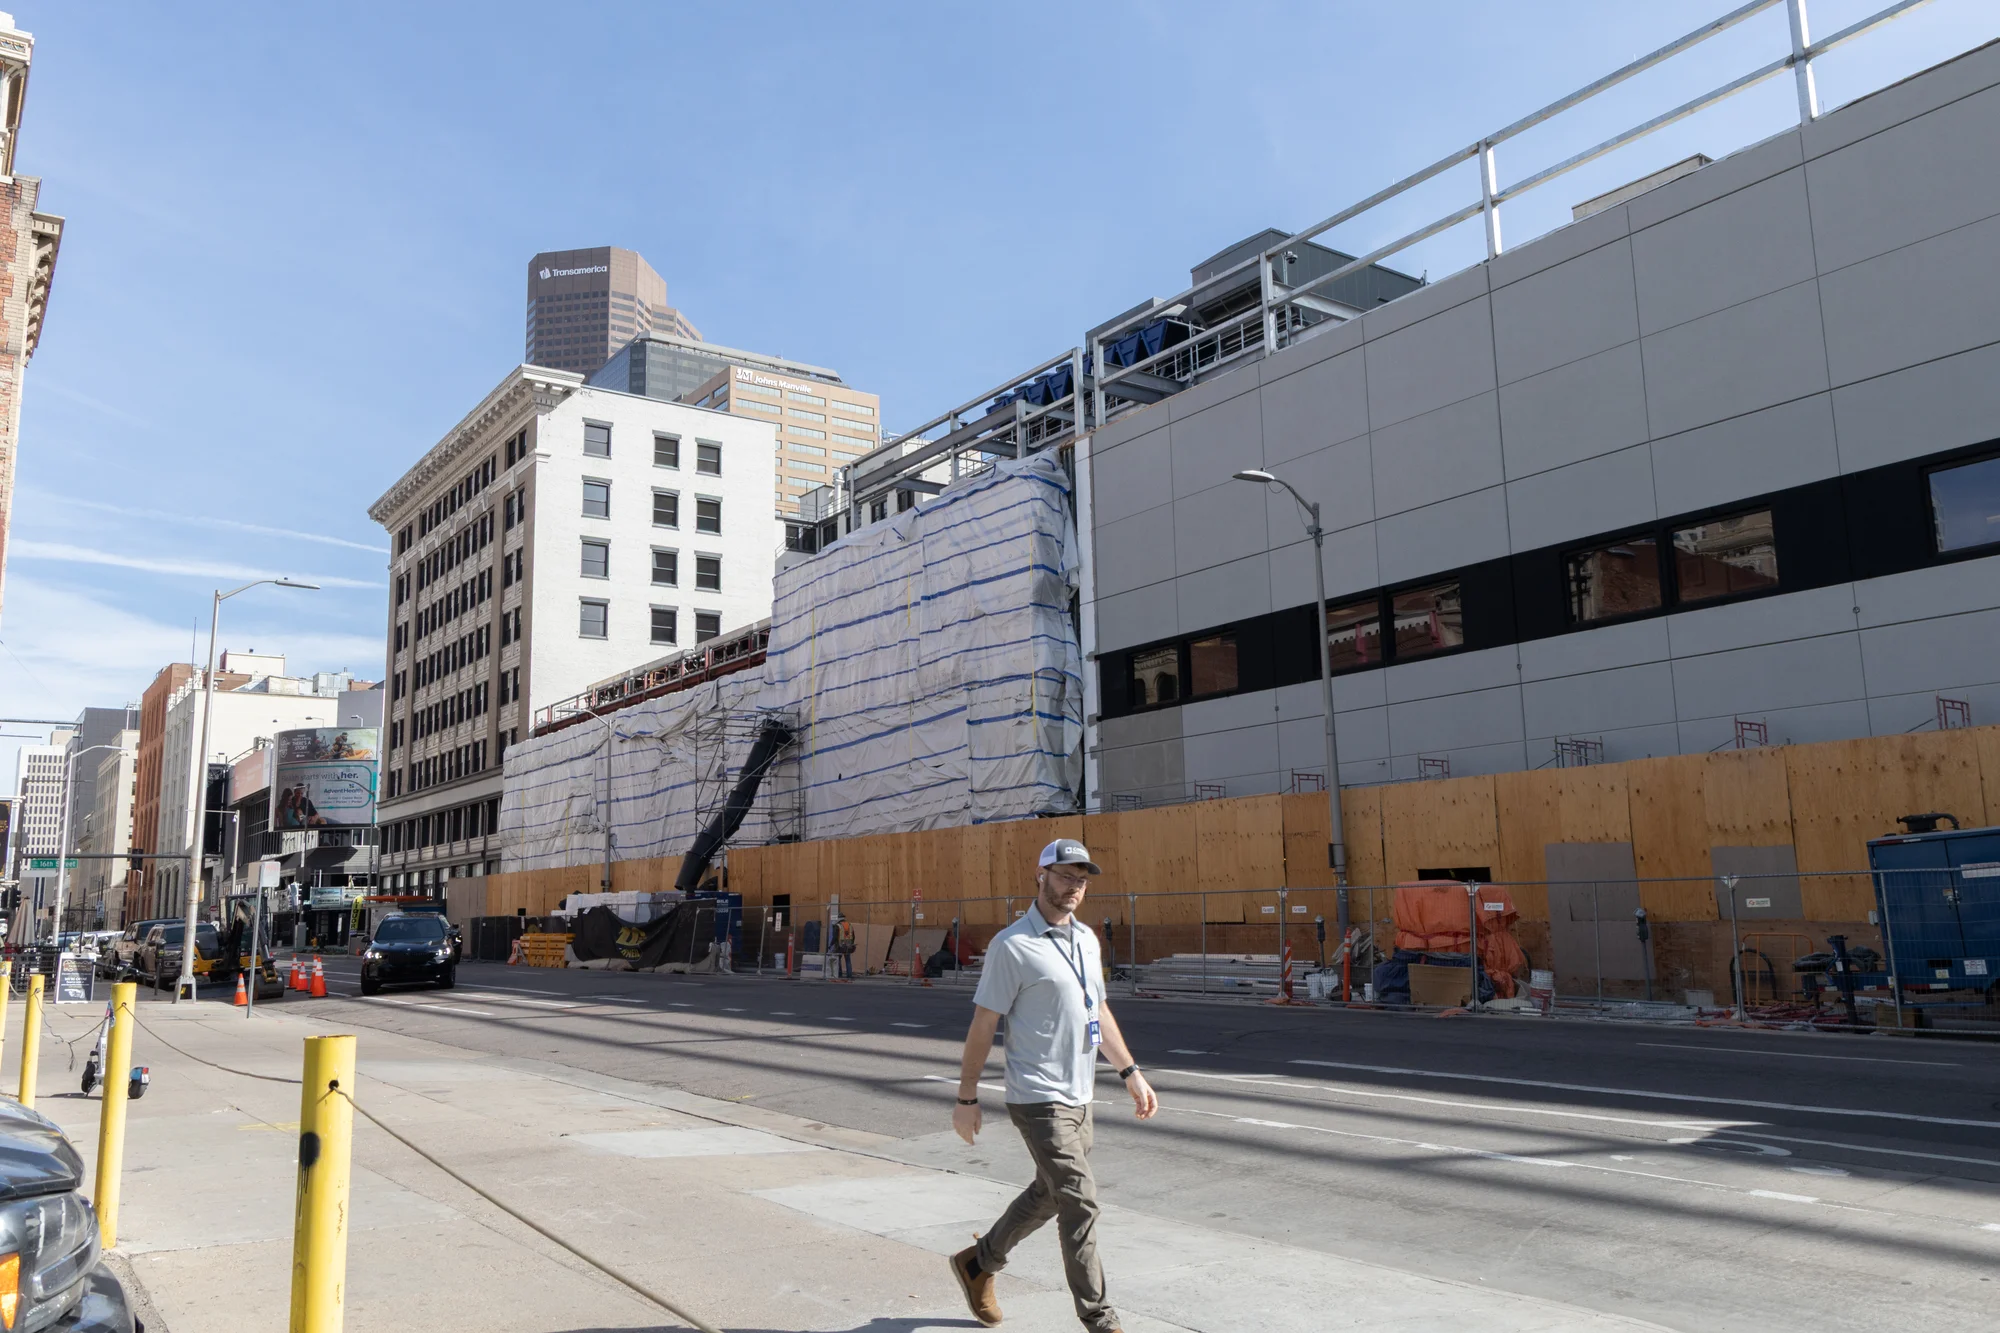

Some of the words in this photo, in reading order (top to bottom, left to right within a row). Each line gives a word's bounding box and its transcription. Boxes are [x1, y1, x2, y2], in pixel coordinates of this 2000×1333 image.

[552, 265, 608, 277] Transamerica
[753, 376, 777, 387] Johns
[778, 380, 812, 393] Manville
[340, 771, 359, 779] her.
[351, 899, 359, 928] LIQUOR
